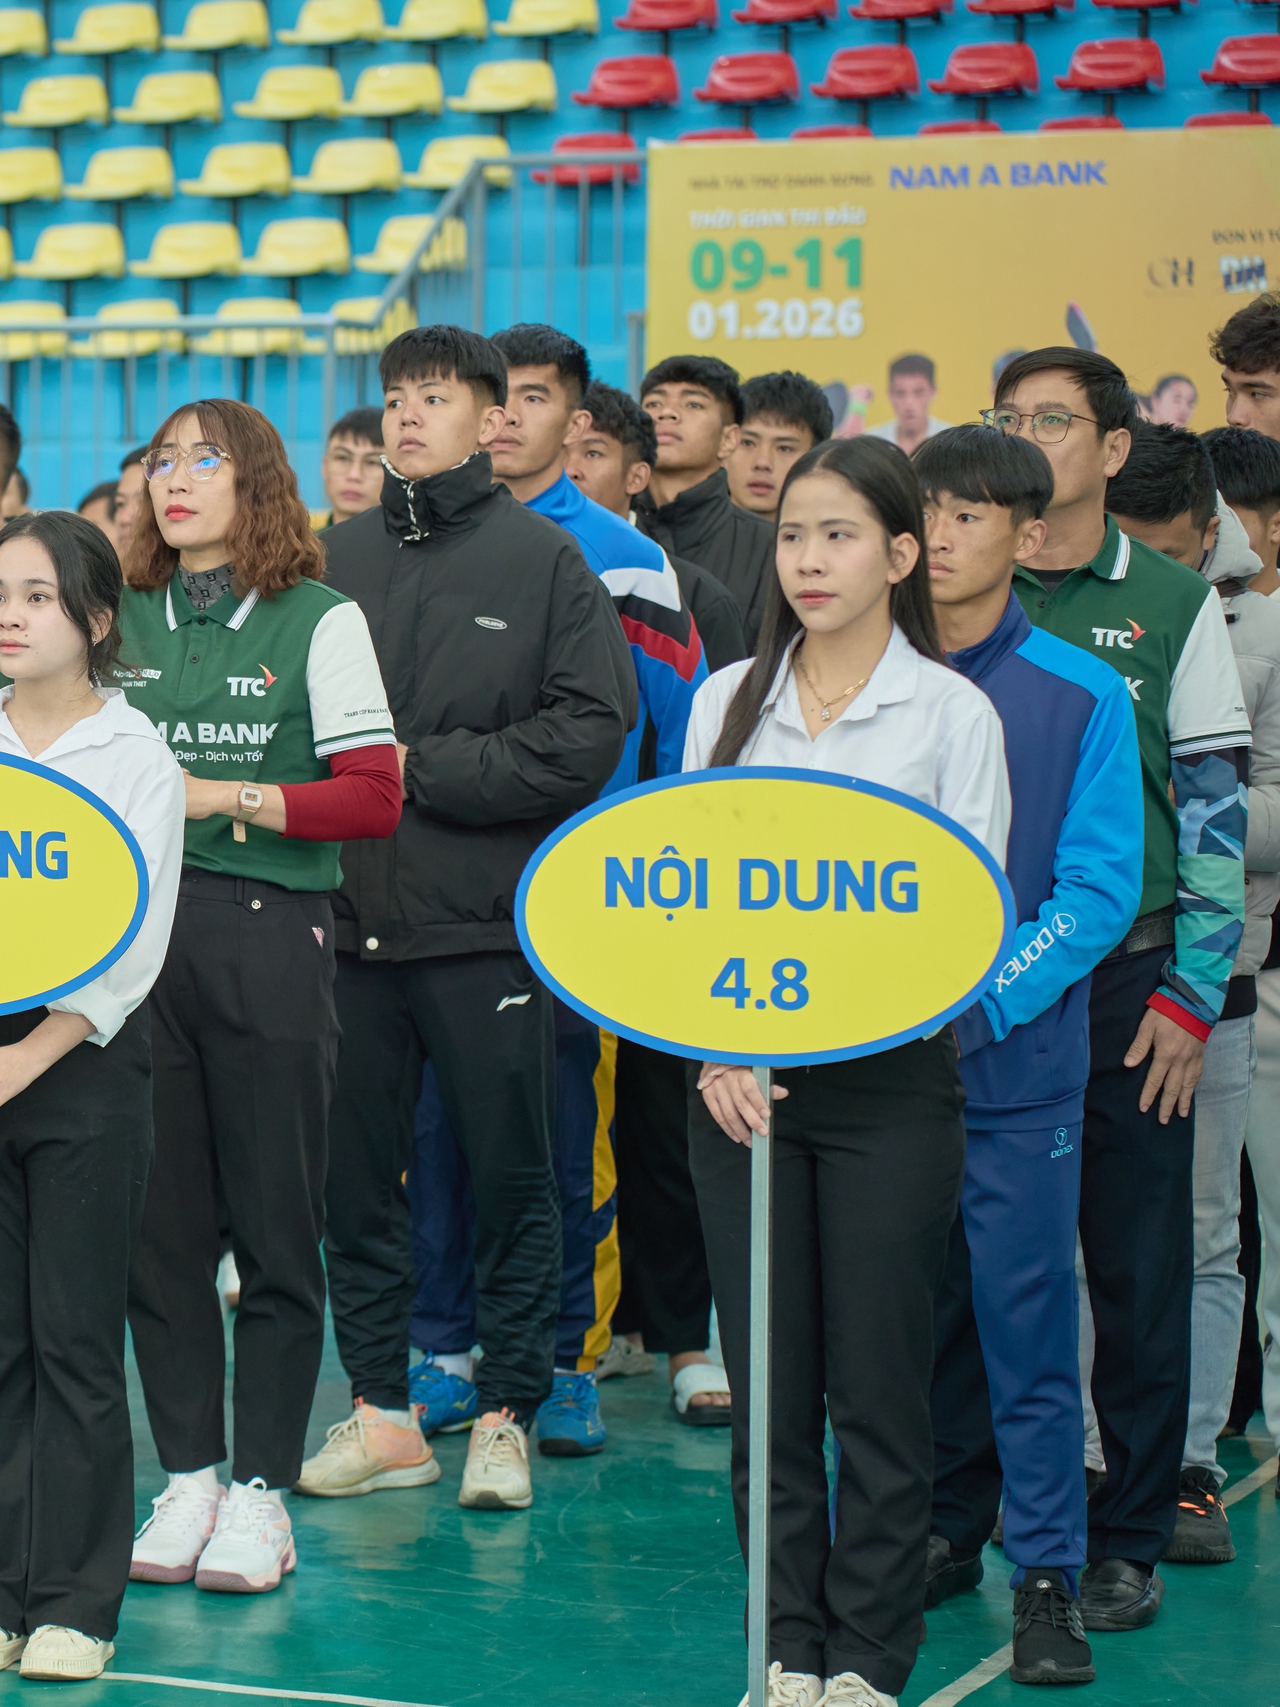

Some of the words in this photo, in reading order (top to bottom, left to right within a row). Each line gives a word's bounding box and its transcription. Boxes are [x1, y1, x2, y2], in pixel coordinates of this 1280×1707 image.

[890, 165, 969, 190] NAM
[978, 163, 1001, 187] A
[1010, 160, 1108, 187] BANK
[691, 237, 862, 292] 09-11
[687, 297, 865, 341] 01.2026
[1091, 627, 1134, 649] TTC
[226, 676, 267, 697] TTC
[171, 722, 193, 743] A
[198, 722, 279, 744] BANK
[175, 750, 197, 762] Đẹp
[206, 751, 228, 763] Dịch
[231, 753, 244, 763] vụ
[244, 750, 264, 762] Tốt
[605, 846, 708, 921] NỘI
[739, 858, 919, 913] DUNG
[994, 927, 1055, 993] DONEX
[710, 958, 810, 1011] 4.8
